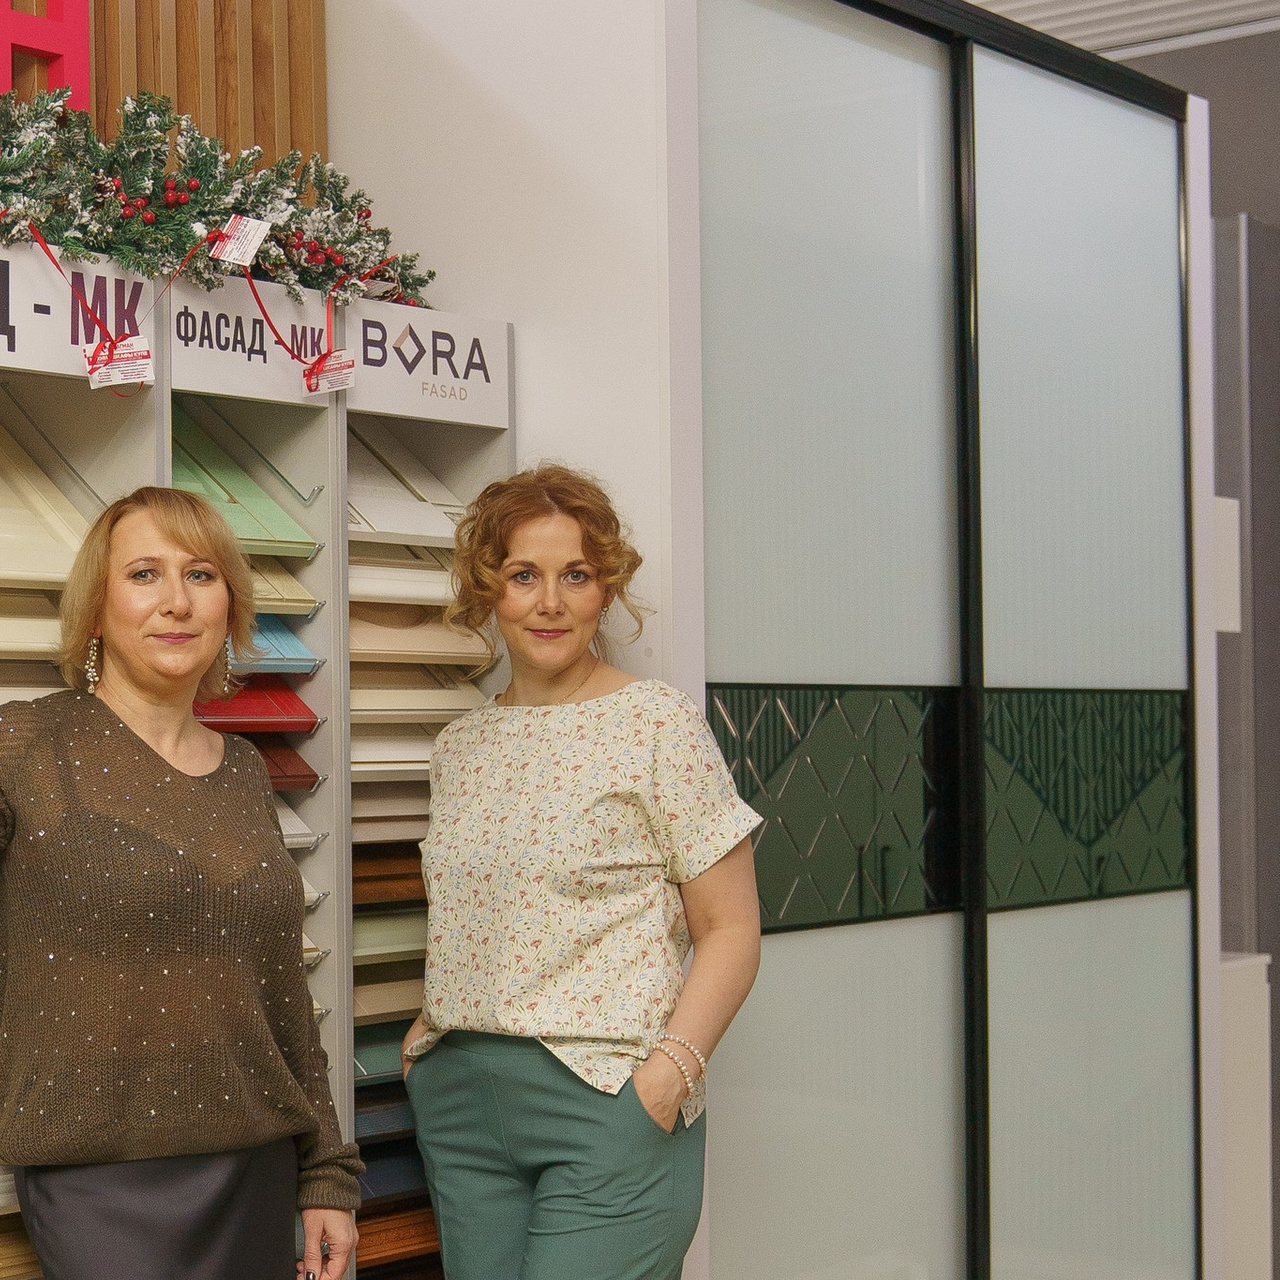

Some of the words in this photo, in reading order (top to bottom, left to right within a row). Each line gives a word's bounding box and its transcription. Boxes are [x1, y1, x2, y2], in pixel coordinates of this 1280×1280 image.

[70, 271, 144, 345] МК
[175, 305, 268, 364] ФАСАД
[290, 323, 325, 360] МК
[362, 318, 491, 384] BORA
[421, 382, 468, 401] FASAD
